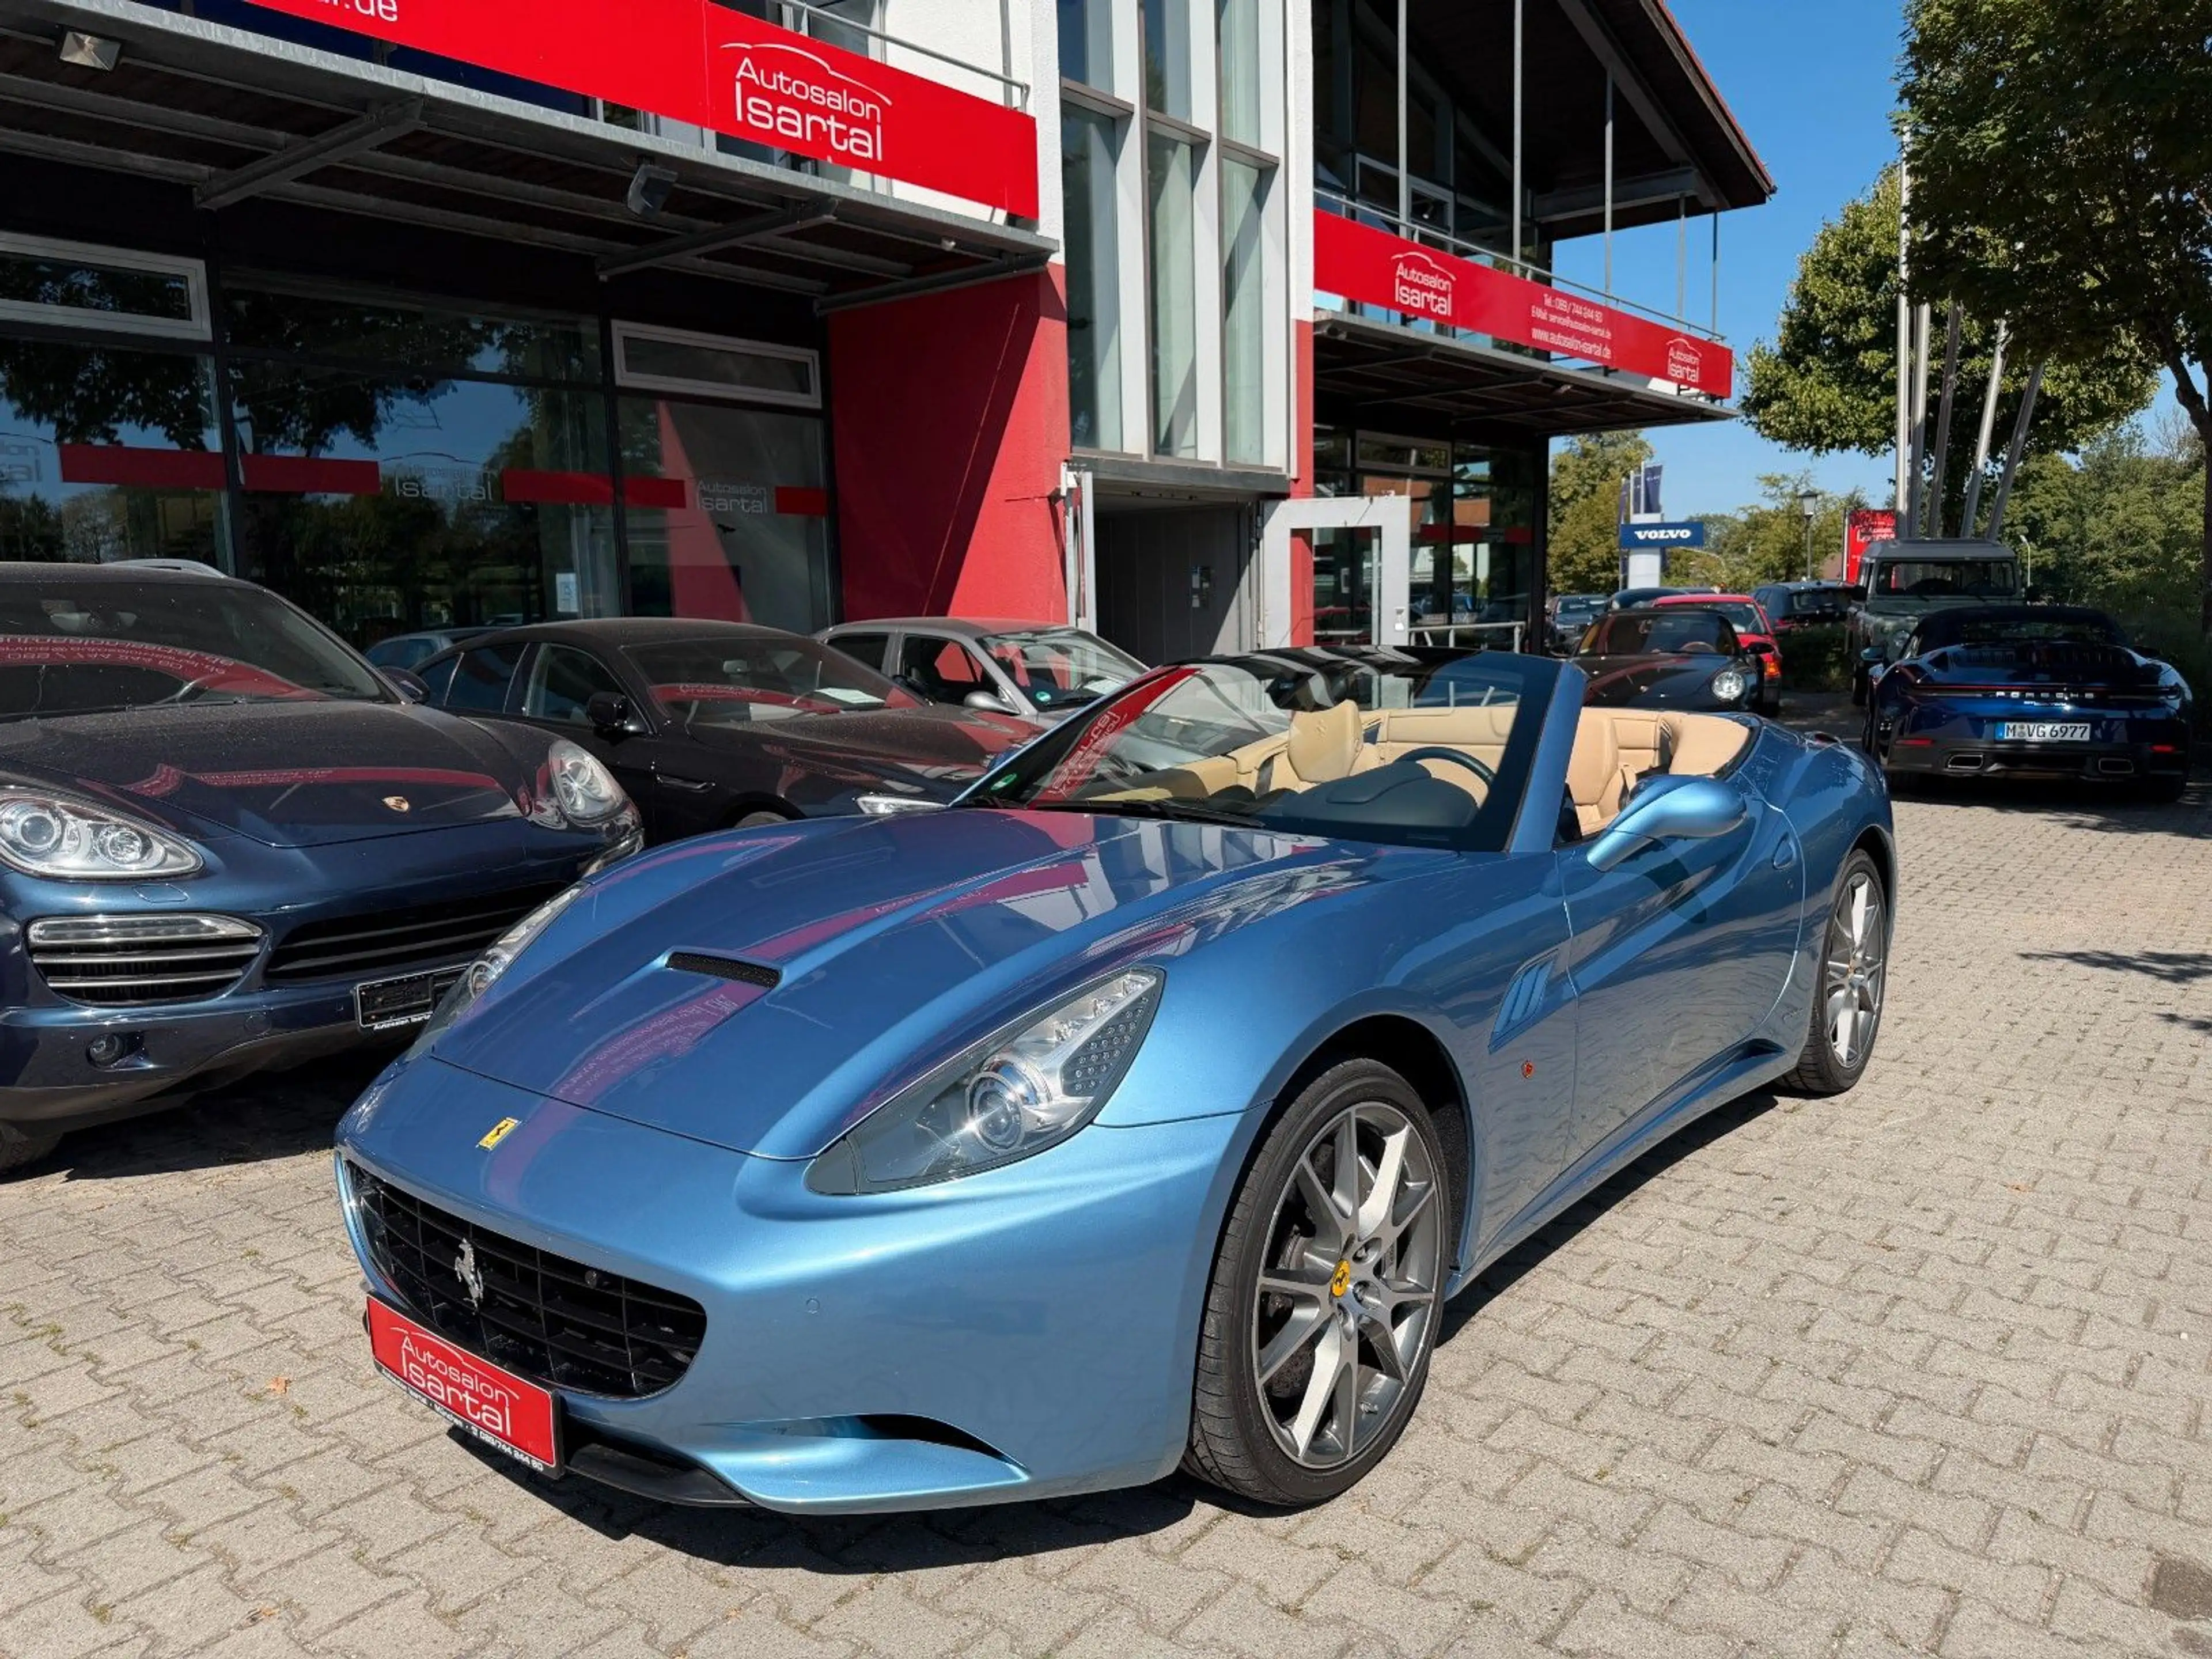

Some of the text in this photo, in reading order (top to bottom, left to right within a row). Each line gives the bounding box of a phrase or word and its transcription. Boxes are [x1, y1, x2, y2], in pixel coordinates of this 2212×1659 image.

[735, 56, 882, 123] Autosalon
[735, 81, 883, 162] Isartal
[1396, 262, 1452, 292] Autosalon
[1395, 277, 1452, 317] Isartal
[1668, 346, 1700, 366] Autosalon
[1667, 357, 1700, 384] Isartal
[698, 479, 768, 496] Autosalon
[696, 491, 768, 514] Isartal
[1634, 529, 1692, 540] VOLVO
[2006, 724, 2089, 738] M VG 6977
[402, 1335, 510, 1407] Autosalon
[400, 1346, 512, 1437] Isartal
